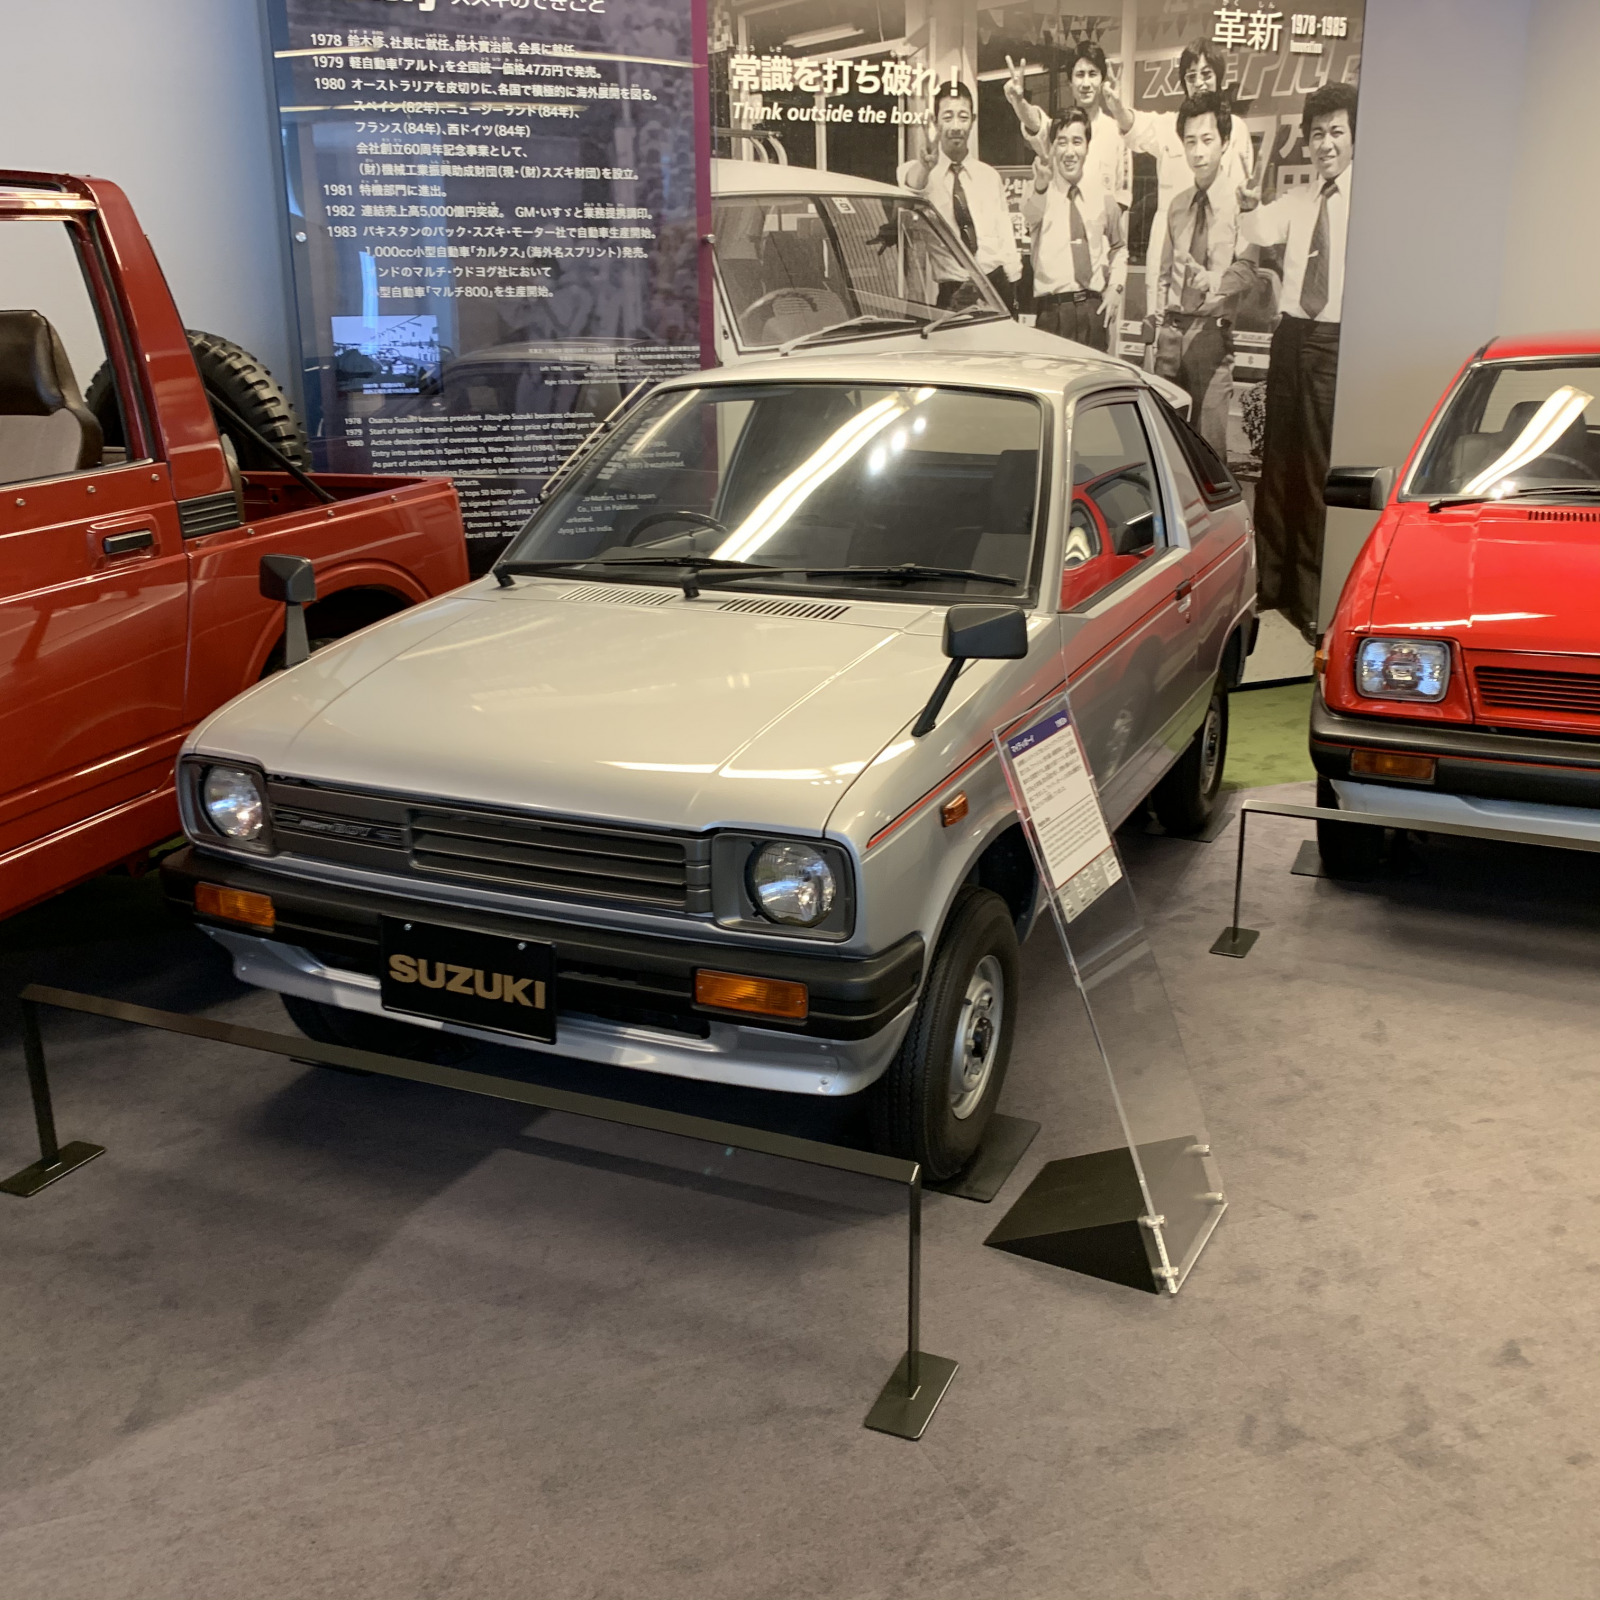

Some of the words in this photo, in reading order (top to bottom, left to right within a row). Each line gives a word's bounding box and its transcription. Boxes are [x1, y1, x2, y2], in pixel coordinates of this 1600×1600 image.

[1211, 8, 1283, 51] 革新
[1291, 14, 1316, 34] 1978
[1321, 16, 1347, 37] 1985
[310, 34, 342, 46] 1978
[312, 56, 344, 69] 1979
[349, 57, 601, 79] 軽自動車「アルト」を全国統一価格47万円で発売。
[731, 54, 959, 97] 常識を打ち破れ！
[314, 77, 346, 90] 1980
[733, 102, 782, 121] Think
[787, 104, 853, 123] outside
[858, 107, 887, 124] the
[890, 108, 930, 125] box!
[356, 143, 528, 158] 会社創立60周年記念事業として、
[324, 184, 353, 196] 1981
[359, 184, 448, 198] 特機部門に進出。
[326, 206, 356, 217] 1982
[327, 226, 358, 238] 1983
[378, 266, 552, 278] ンドのマルチ・ウドヨグ社において
[525, 423, 541, 433] price
[577, 423, 589, 431] yen
[393, 437, 439, 447] development
[479, 435, 514, 445] operations
[372, 449, 390, 459] Entry
[444, 447, 463, 456] Spain
[383, 460, 398, 469] part
[388, 954, 546, 1009] SUZUKI
